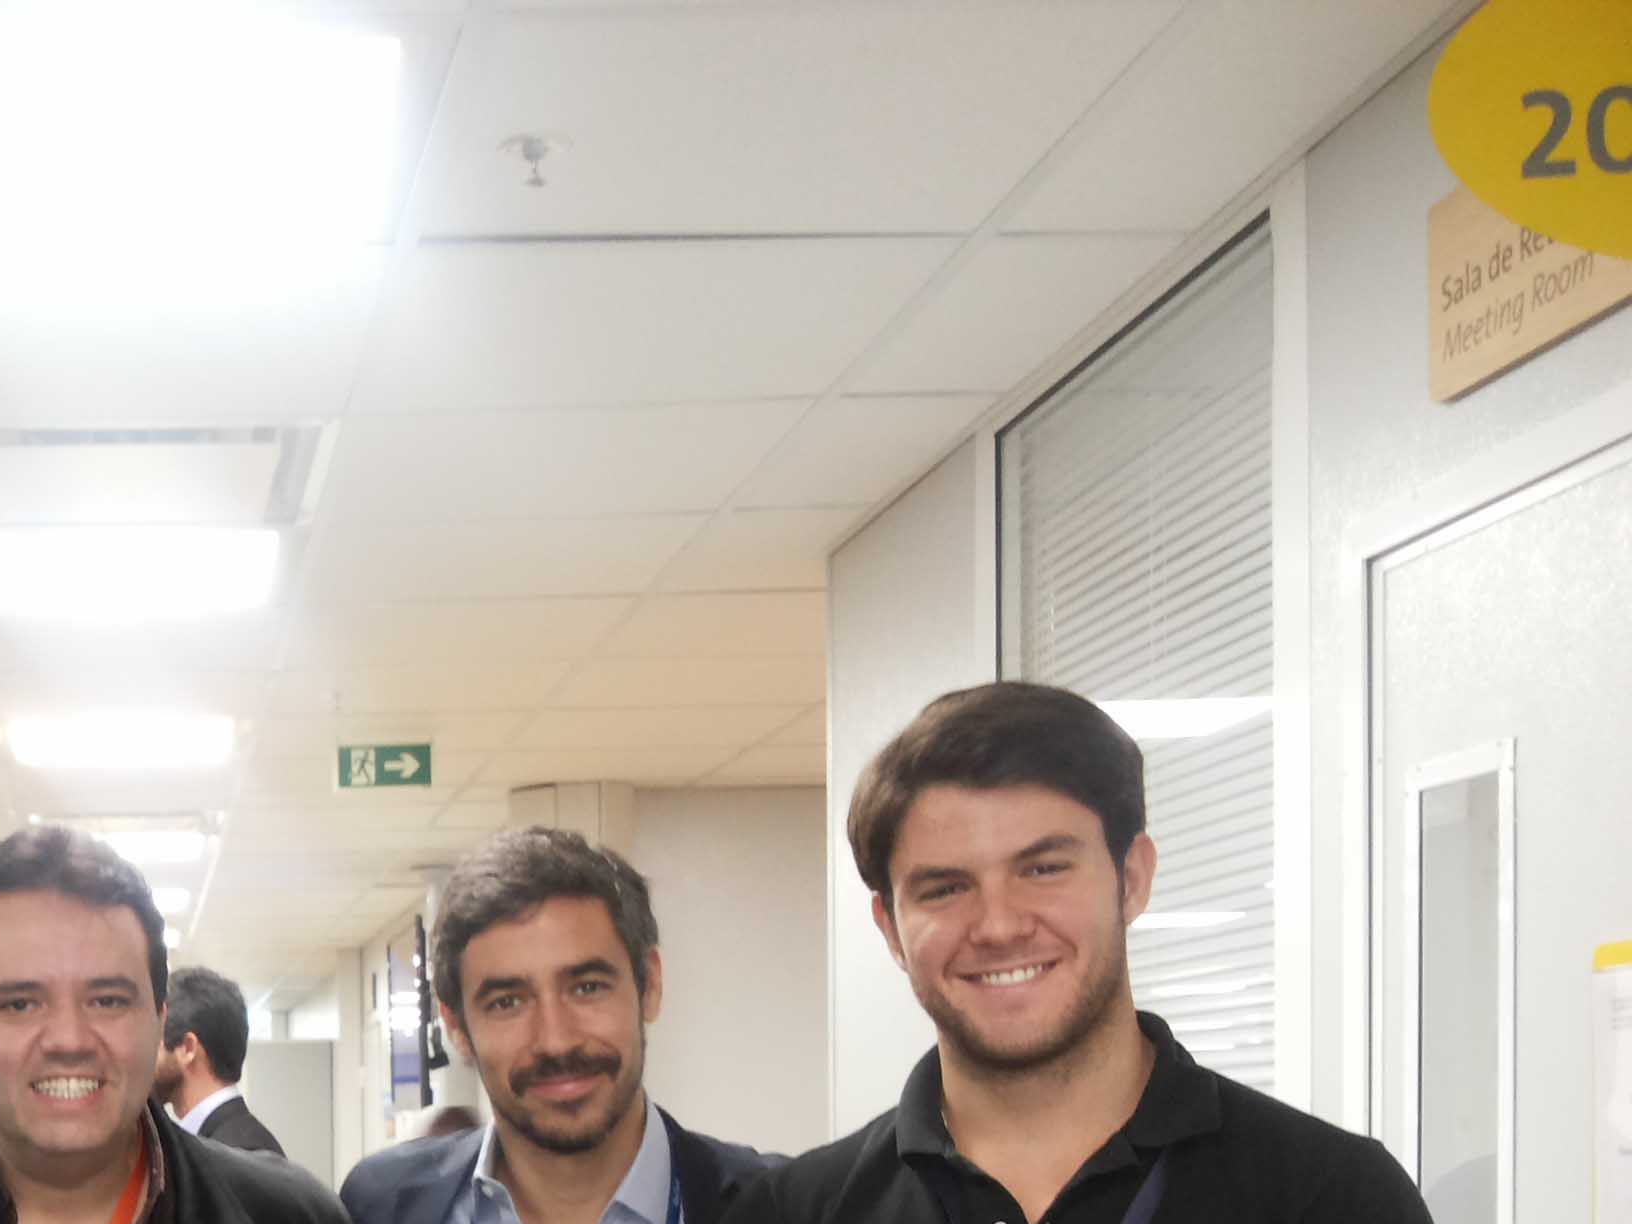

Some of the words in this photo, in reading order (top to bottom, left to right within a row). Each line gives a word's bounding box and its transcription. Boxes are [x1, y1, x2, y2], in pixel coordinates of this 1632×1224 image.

[1441, 262, 1482, 312] Sala
[1488, 240, 1513, 281] de
[1442, 291, 1525, 361] Meeting
[1531, 250, 1593, 311] Room
